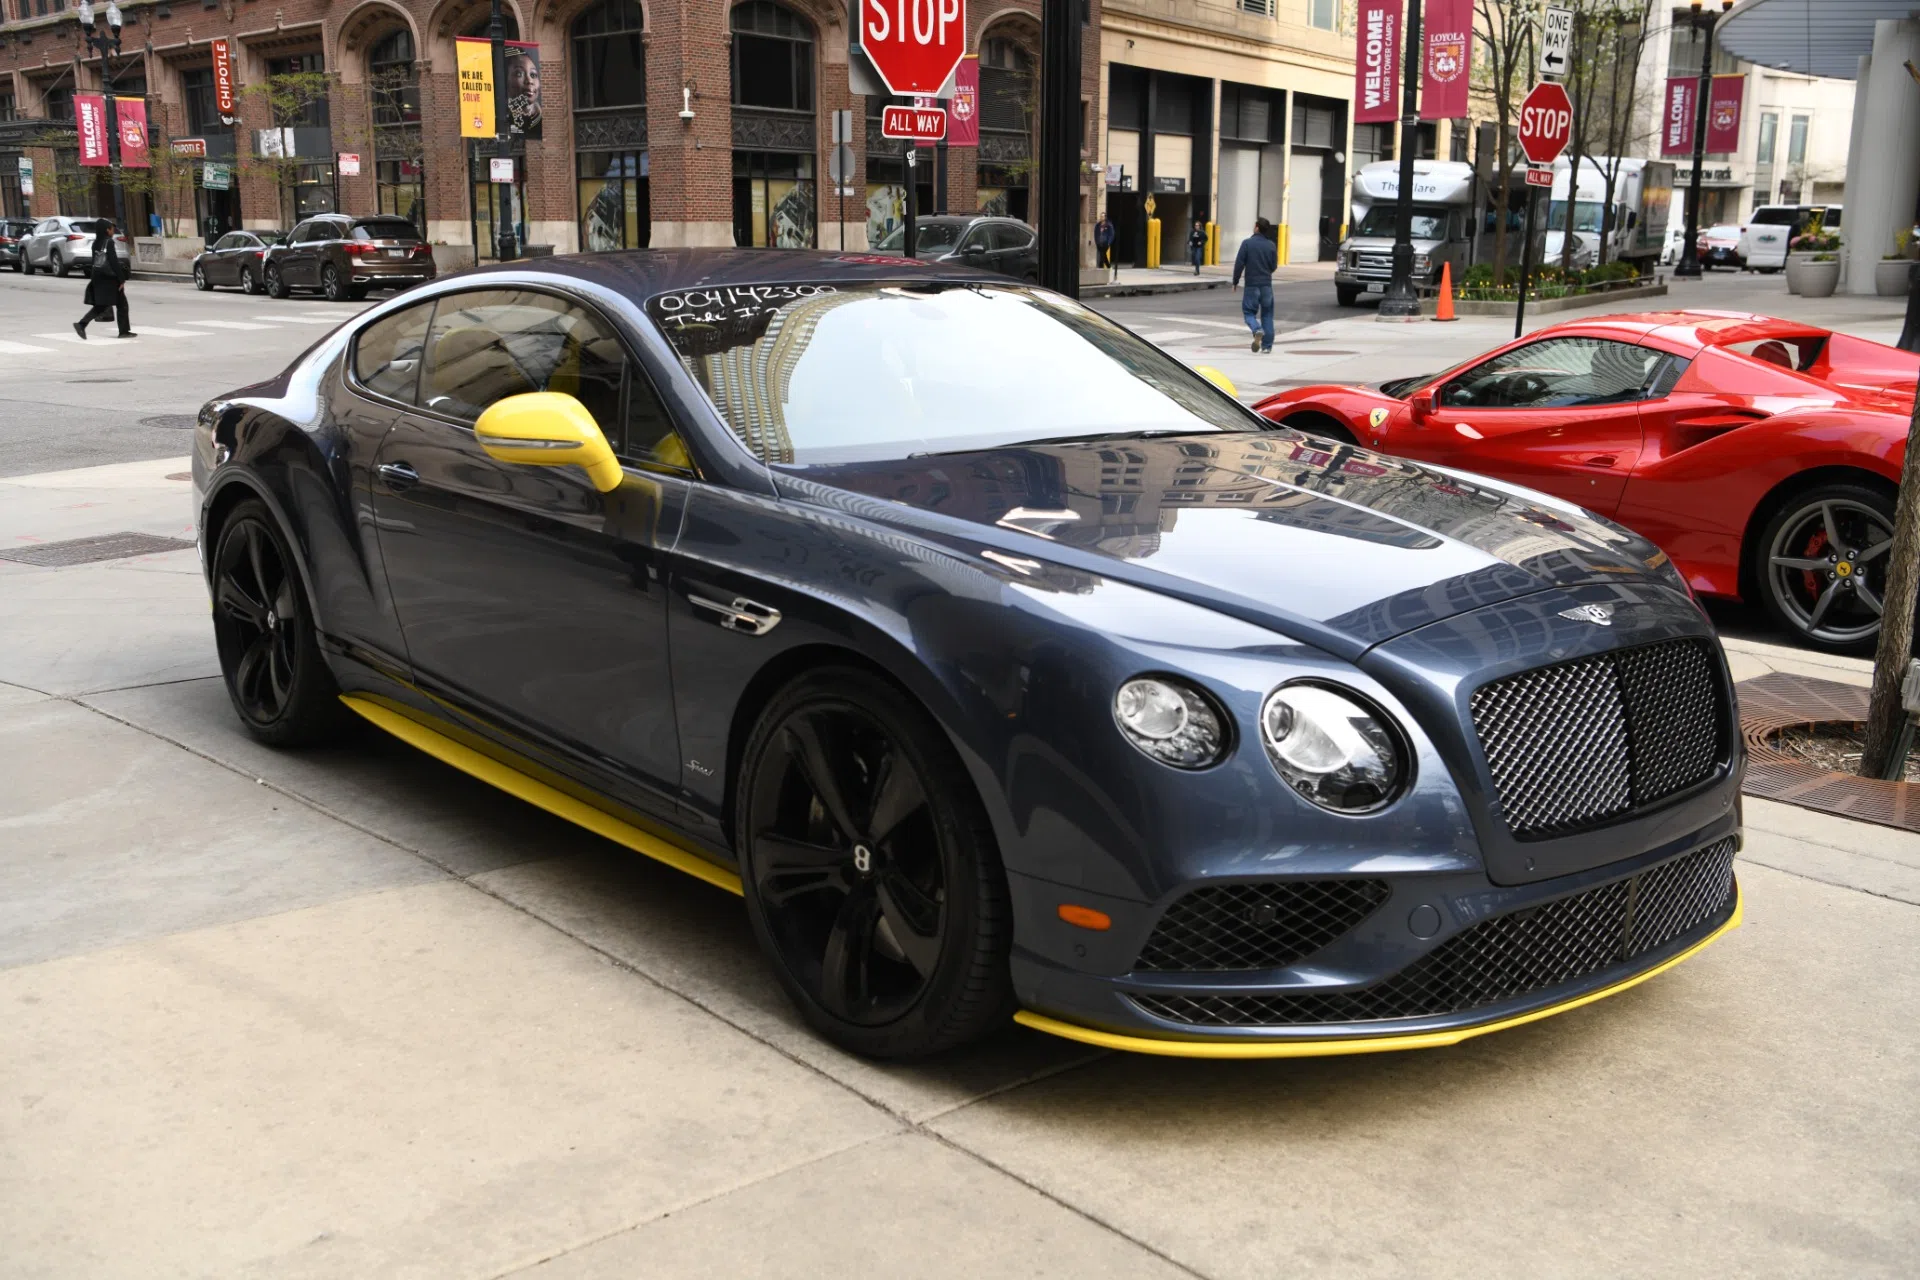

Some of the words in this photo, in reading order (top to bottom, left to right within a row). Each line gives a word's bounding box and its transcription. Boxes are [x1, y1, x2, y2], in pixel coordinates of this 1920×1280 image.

[868, 0, 959, 45] STOP
[1385, 14, 1394, 46] CAMPUS
[1548, 13, 1569, 31] ONE
[1430, 32, 1465, 42] LOYOLA
[1545, 31, 1567, 49] WAY
[1364, 9, 1384, 110] WELCOME
[1384, 48, 1393, 75] TOWER
[216, 43, 232, 109] CHIPOTLE
[461, 70, 470, 80] WE
[472, 71, 483, 81] ARE
[462, 81, 483, 92] CALLED
[484, 83, 492, 92] TO
[1383, 77, 1392, 103] WATER
[462, 92, 480, 103] SOLVE
[889, 113, 912, 131] ALL
[917, 114, 941, 132] WAY
[1522, 106, 1569, 139] STOP
[1668, 84, 1685, 147] WELCOME
[80, 102, 97, 159] WELCOME
[173, 144, 200, 153] CHIPOTLE
[1381, 181, 1400, 192] The
[1414, 182, 1436, 194] lare
[1528, 172, 1539, 182] ALL
[1540, 174, 1552, 184] WAY
